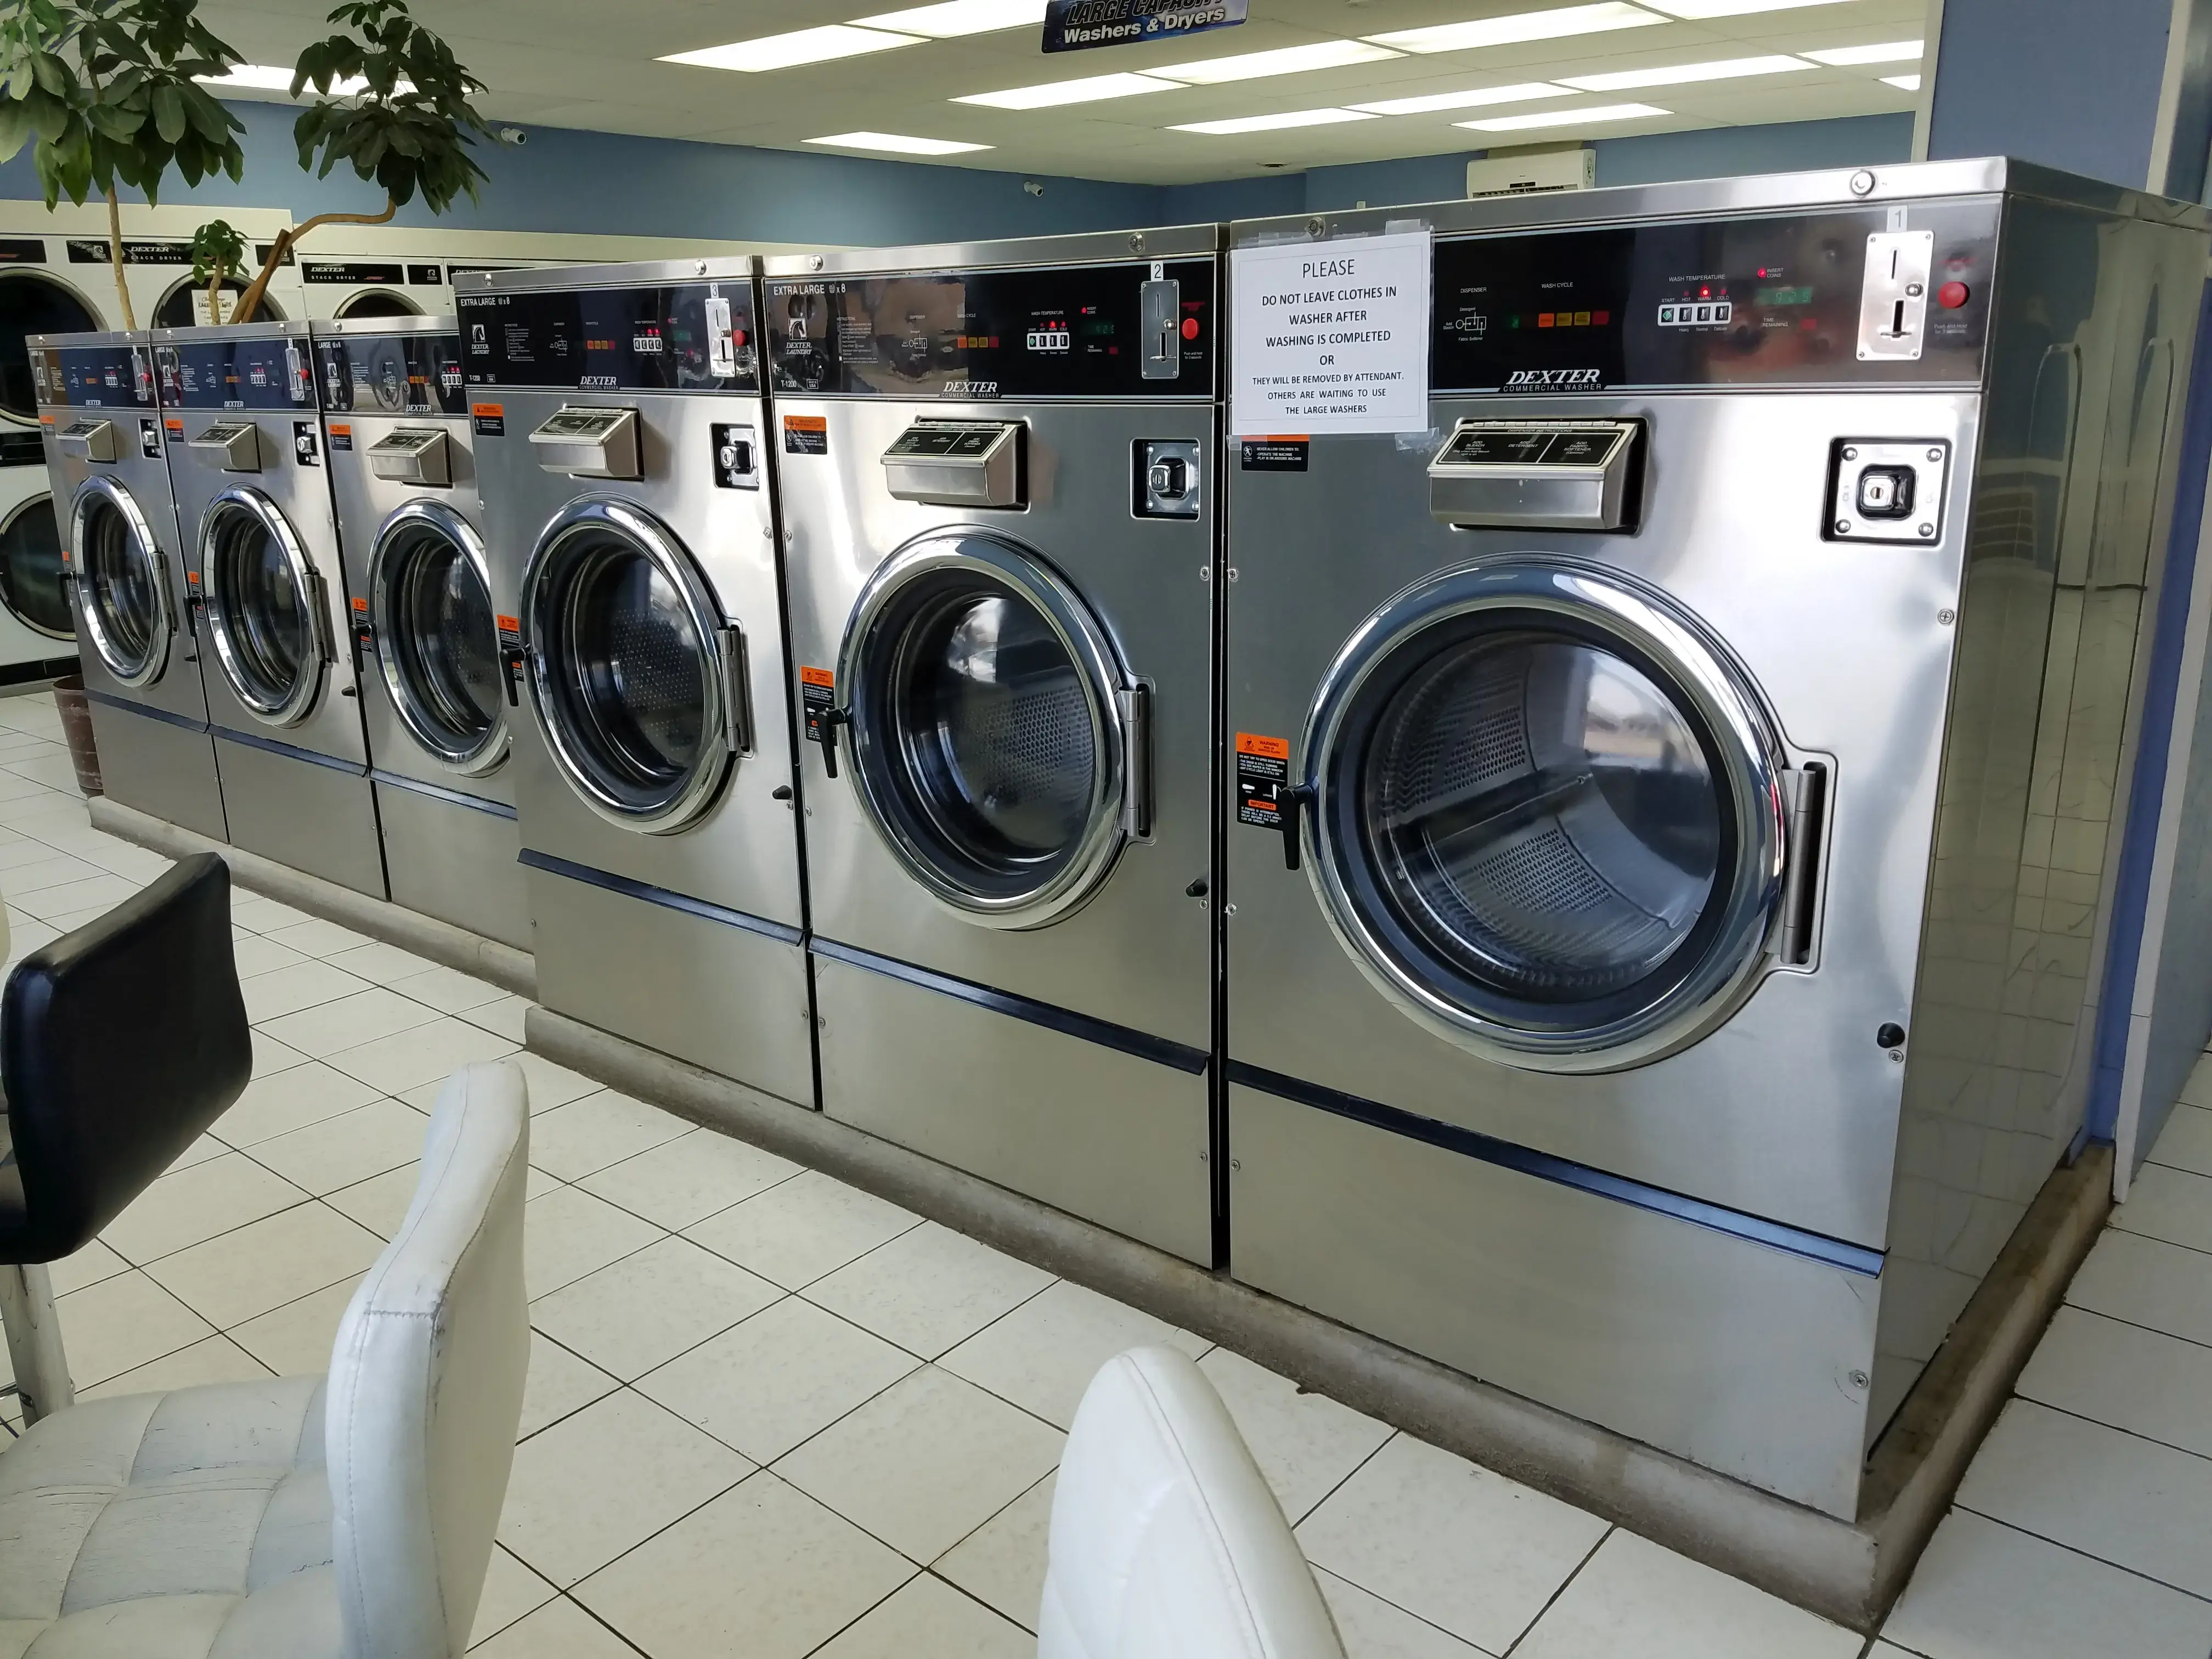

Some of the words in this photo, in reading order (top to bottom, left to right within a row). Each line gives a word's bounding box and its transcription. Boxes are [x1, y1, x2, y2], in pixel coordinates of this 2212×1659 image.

[1065, 0, 1131, 25] LARGE
[1064, 23, 1141, 44] Washers
[1146, 18, 1159, 32] &
[1164, 8, 1224, 30] Dryers
[1894, 210, 1902, 228] 1
[1154, 264, 1161, 278] 2
[1302, 259, 1355, 278] PLEASE
[712, 285, 718, 296] 3
[774, 285, 798, 296] EXTRA
[799, 284, 825, 295] LARGE
[841, 283, 846, 293] 8
[1262, 295, 1277, 306] DO
[1280, 294, 1301, 305] NOT
[1304, 291, 1335, 303] LEAVE
[1338, 287, 1383, 301] CLOTHES
[1386, 286, 1397, 297] IN
[460, 298, 478, 307] EXTRA
[478, 297, 496, 306] LARGE
[506, 296, 510, 304] 8
[1289, 312, 1333, 325] WASHER
[1335, 310, 1367, 323] AFTER
[289, 340, 293, 348] 5
[1266, 335, 1314, 347] WASHING
[1317, 334, 1326, 345] IS
[1329, 330, 1391, 344] COMPLETED
[1319, 355, 1335, 365] OR
[580, 376, 617, 385] DEXTER
[1252, 377, 1271, 385] THEY
[1272, 376, 1290, 385] WILL
[1302, 374, 1341, 383] REMOVED
[1344, 374, 1353, 382] BY
[1355, 371, 1404, 381] ATTENDANT.
[1505, 369, 1600, 385] DEXTER
[781, 380, 797, 388] T-1200
[943, 382, 998, 393] DEXTER
[1268, 391, 1296, 400] OTHERS
[1300, 391, 1315, 399] ARE
[1319, 390, 1353, 398] WAITING
[1358, 389, 1368, 397] TO
[1372, 388, 1386, 397] USE
[1304, 406, 1328, 414] LARGE
[1330, 405, 1367, 414] WASHERS
